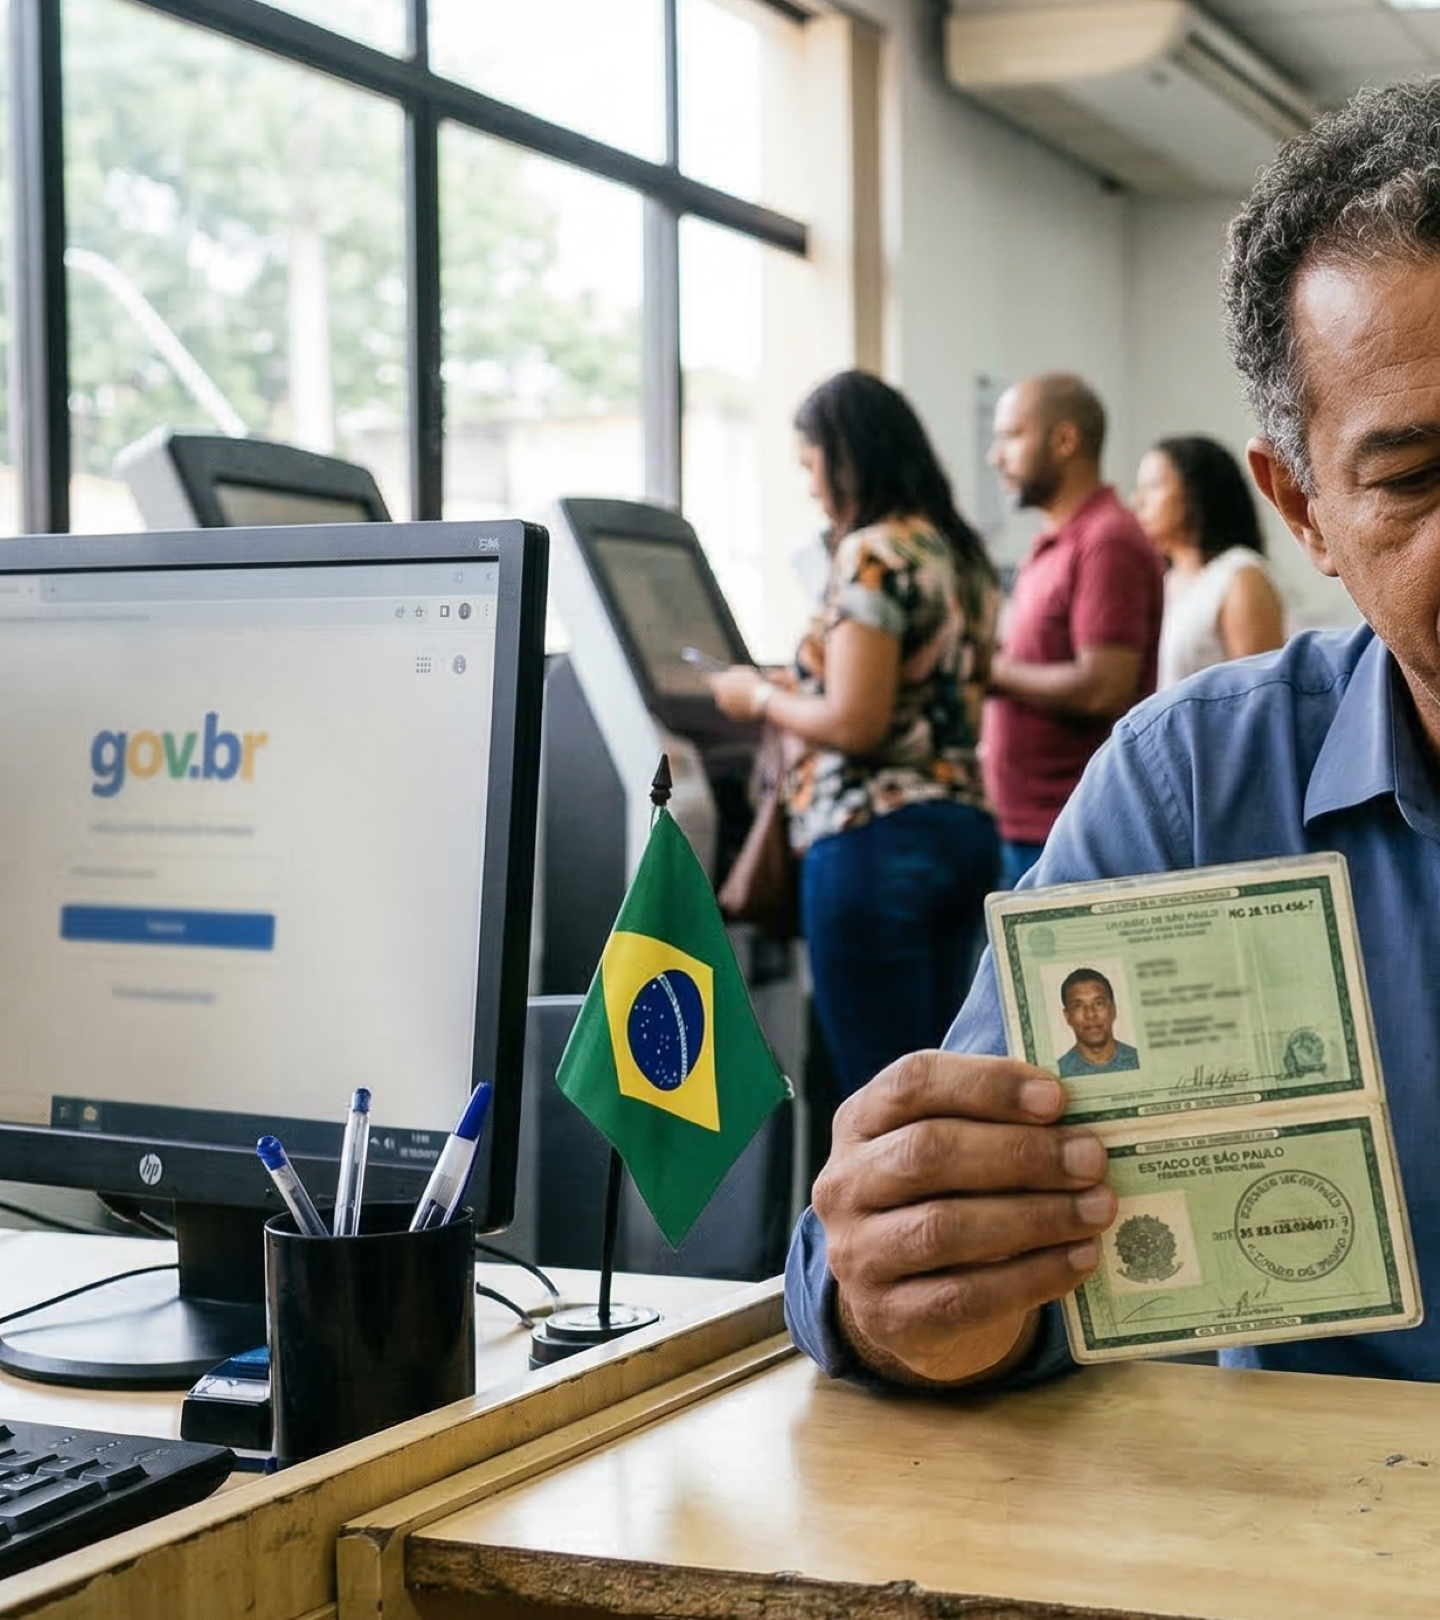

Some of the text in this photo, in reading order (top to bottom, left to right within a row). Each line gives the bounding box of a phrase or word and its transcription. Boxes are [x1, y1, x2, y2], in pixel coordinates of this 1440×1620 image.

[91, 711, 269, 798] gov.br
[140, 1153, 164, 1186] hp
[1213, 1150, 1240, 1165] SÃO
[1243, 1146, 1285, 1161] PAULO
